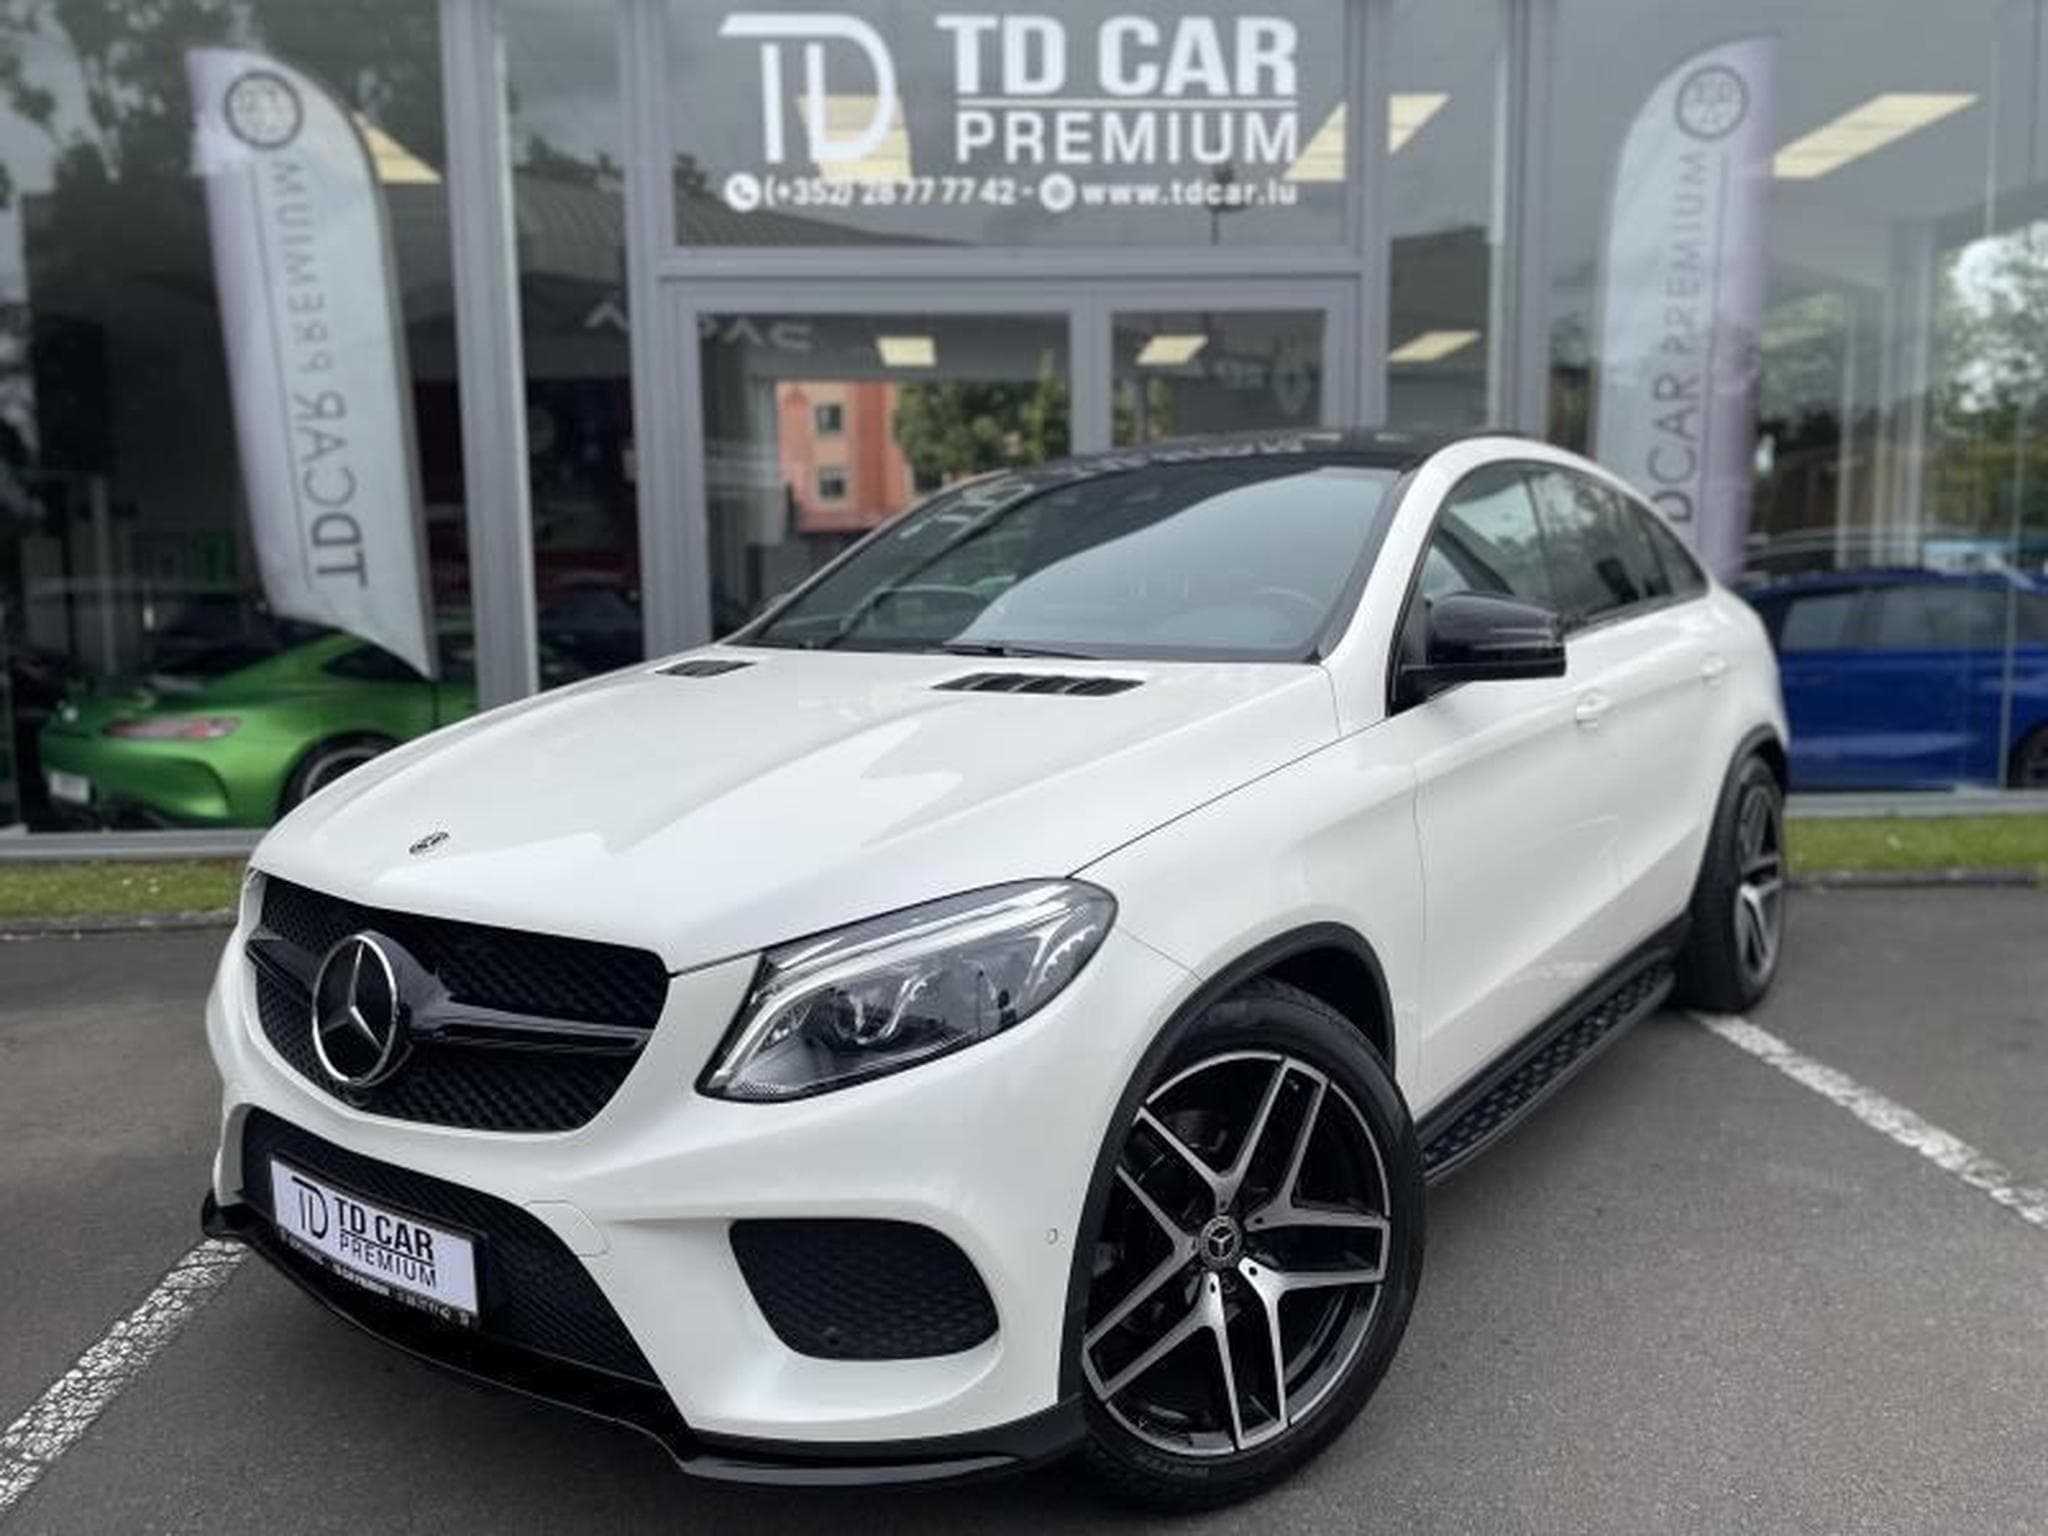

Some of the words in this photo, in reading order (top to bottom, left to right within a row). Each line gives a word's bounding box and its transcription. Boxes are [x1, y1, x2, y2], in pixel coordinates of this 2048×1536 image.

[936, 16, 1066, 95] TD
[1100, 15, 1298, 96] CAR
[957, 111, 1298, 163] PREMIUM
[1081, 179, 1298, 206] www.tdcar.lu
[1660, 151, 1708, 353] PREMIUM
[1647, 371, 1701, 524] DCAR
[335, 1196, 367, 1236] TD
[374, 1213, 436, 1262] CAR
[339, 1233, 438, 1288] PREMIUM
